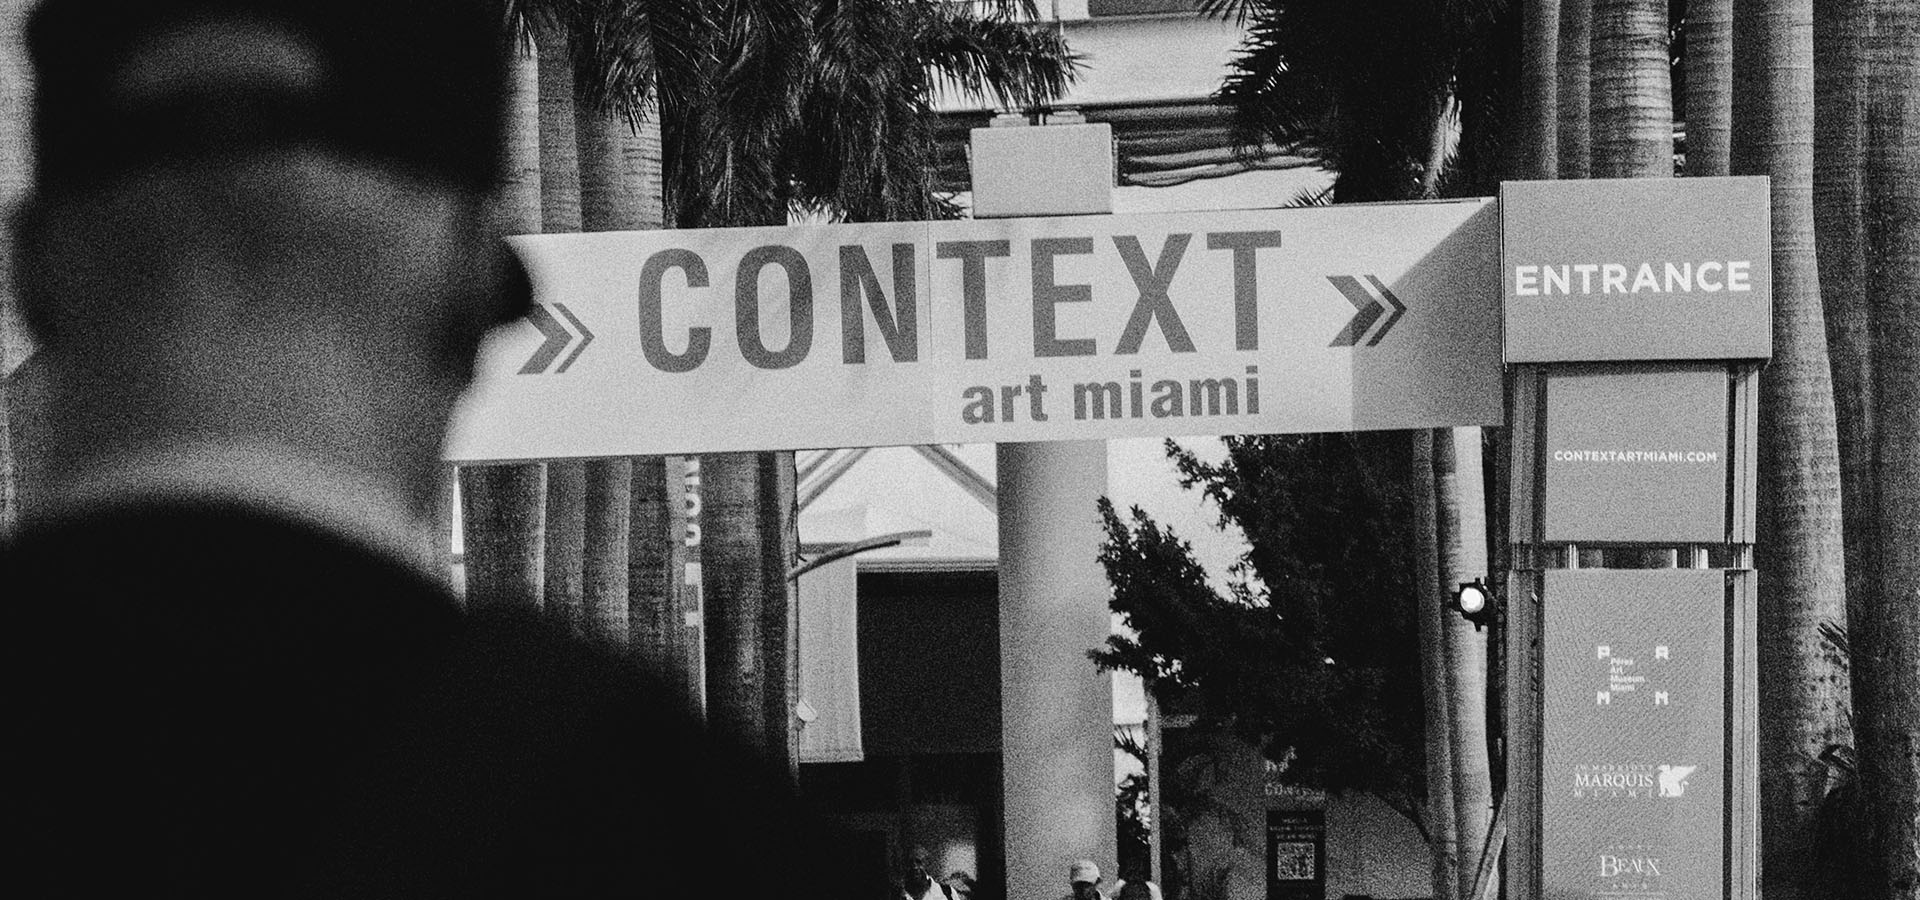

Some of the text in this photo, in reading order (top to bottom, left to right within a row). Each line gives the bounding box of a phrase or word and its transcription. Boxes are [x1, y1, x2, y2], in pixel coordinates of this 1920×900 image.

[1515, 261, 1751, 296] ENTRANCE
[638, 230, 1282, 373] CONTEXT
[962, 365, 1260, 425] art miami
[1554, 450, 1718, 463] CONTEXTARTMIAMI.COM
[1575, 773, 1654, 789] MARQUIS
